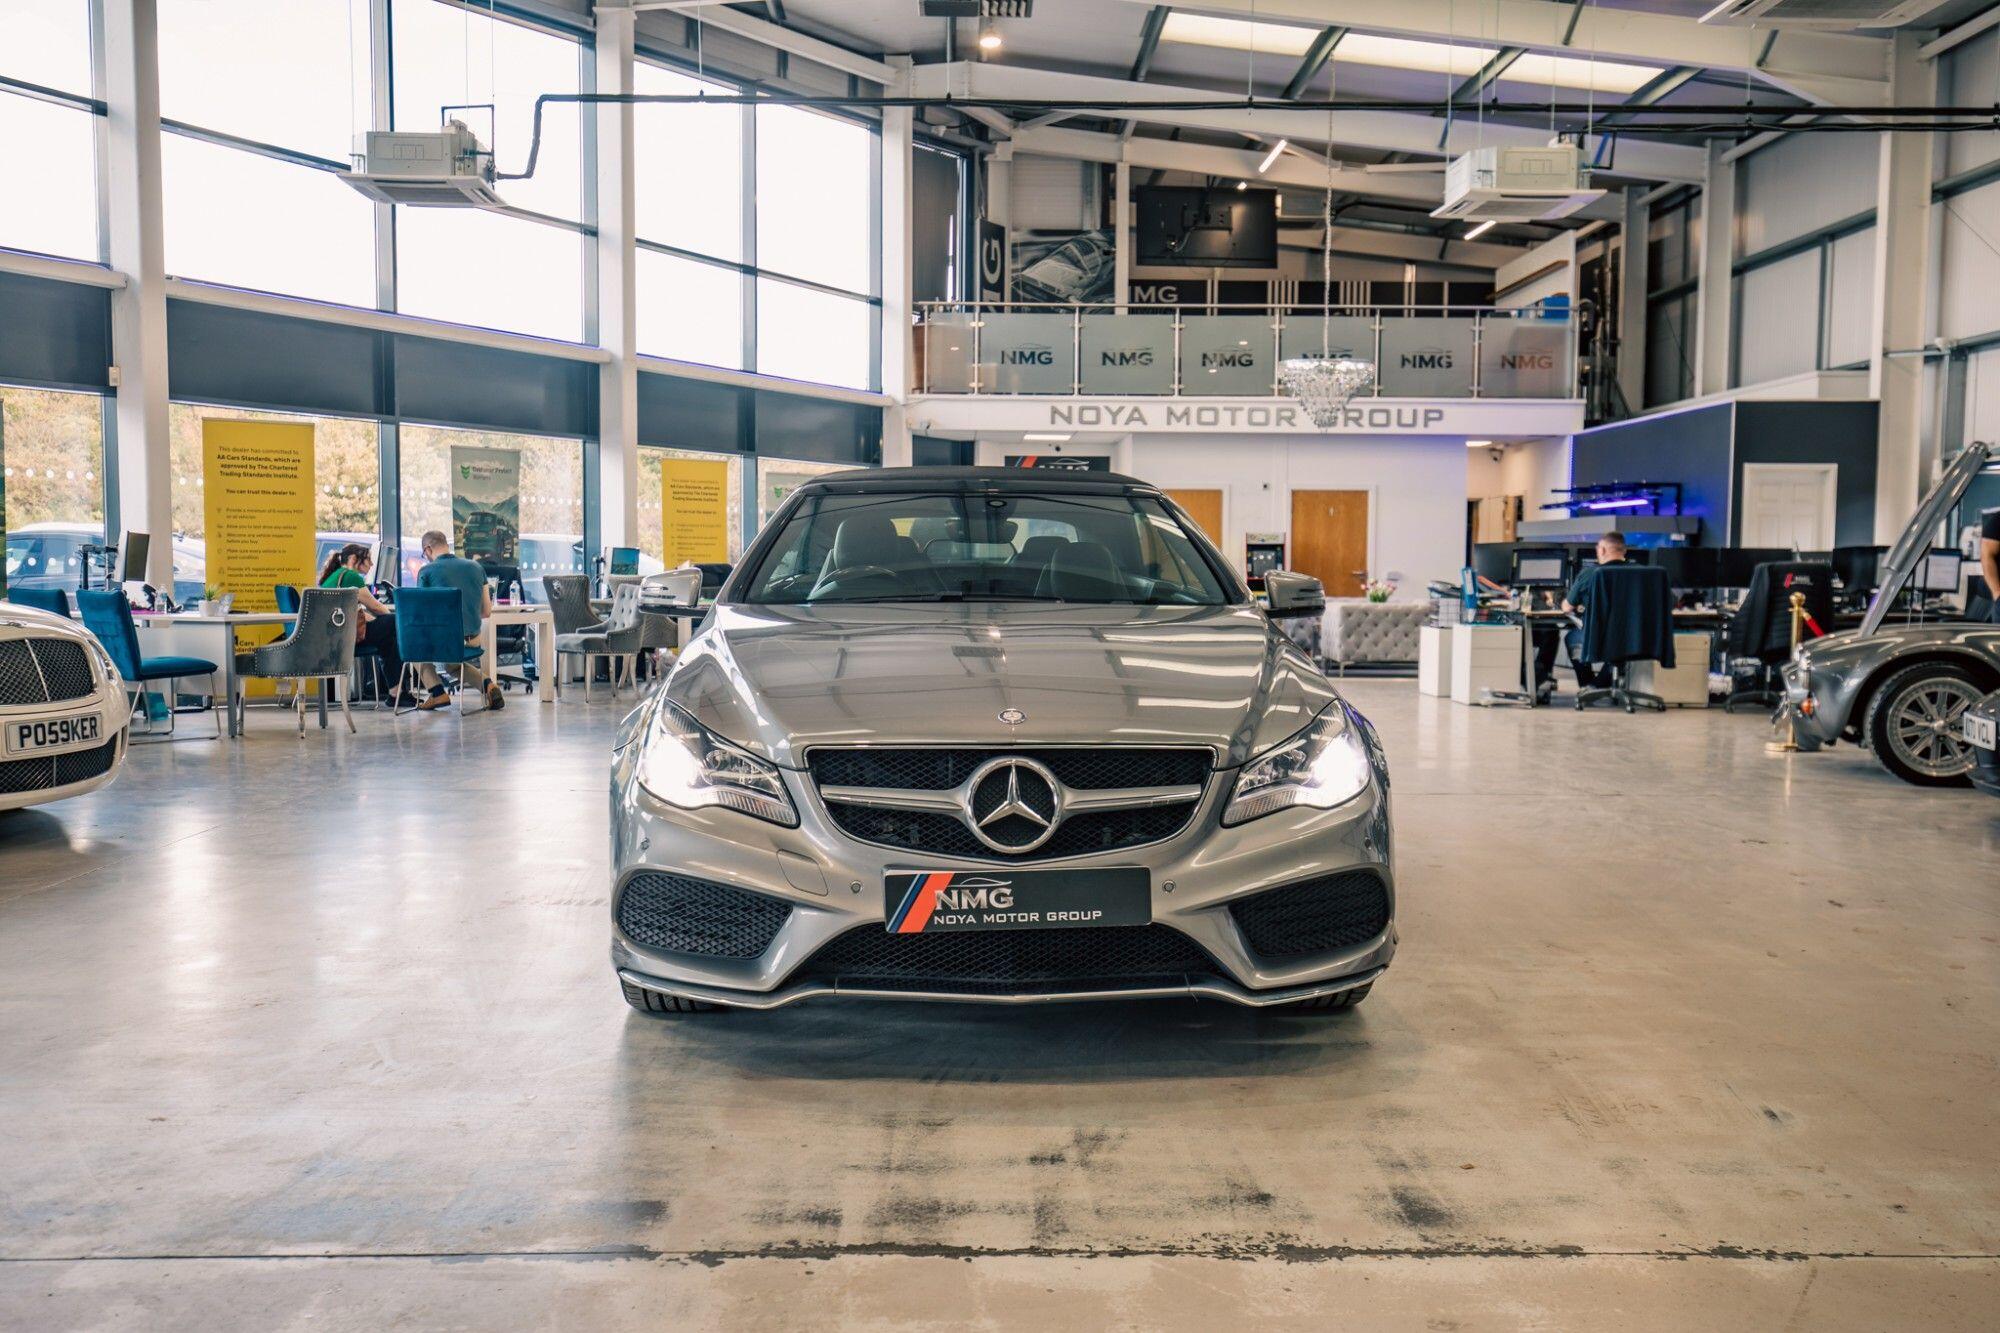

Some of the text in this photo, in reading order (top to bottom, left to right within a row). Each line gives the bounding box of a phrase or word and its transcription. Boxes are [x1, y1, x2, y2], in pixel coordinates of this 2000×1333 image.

[1001, 350, 1053, 365] NMG
[1102, 351, 1154, 366] NMG
[1202, 353, 1254, 367] NMG
[1401, 354, 1453, 369] NMG
[1501, 355, 1553, 369] NMG
[1050, 405, 1148, 426] NOYA
[1166, 406, 1297, 427] MOTOR
[935, 888, 1014, 911] NMG
[934, 910, 1102, 924] NOYA MOTOR GROUP
